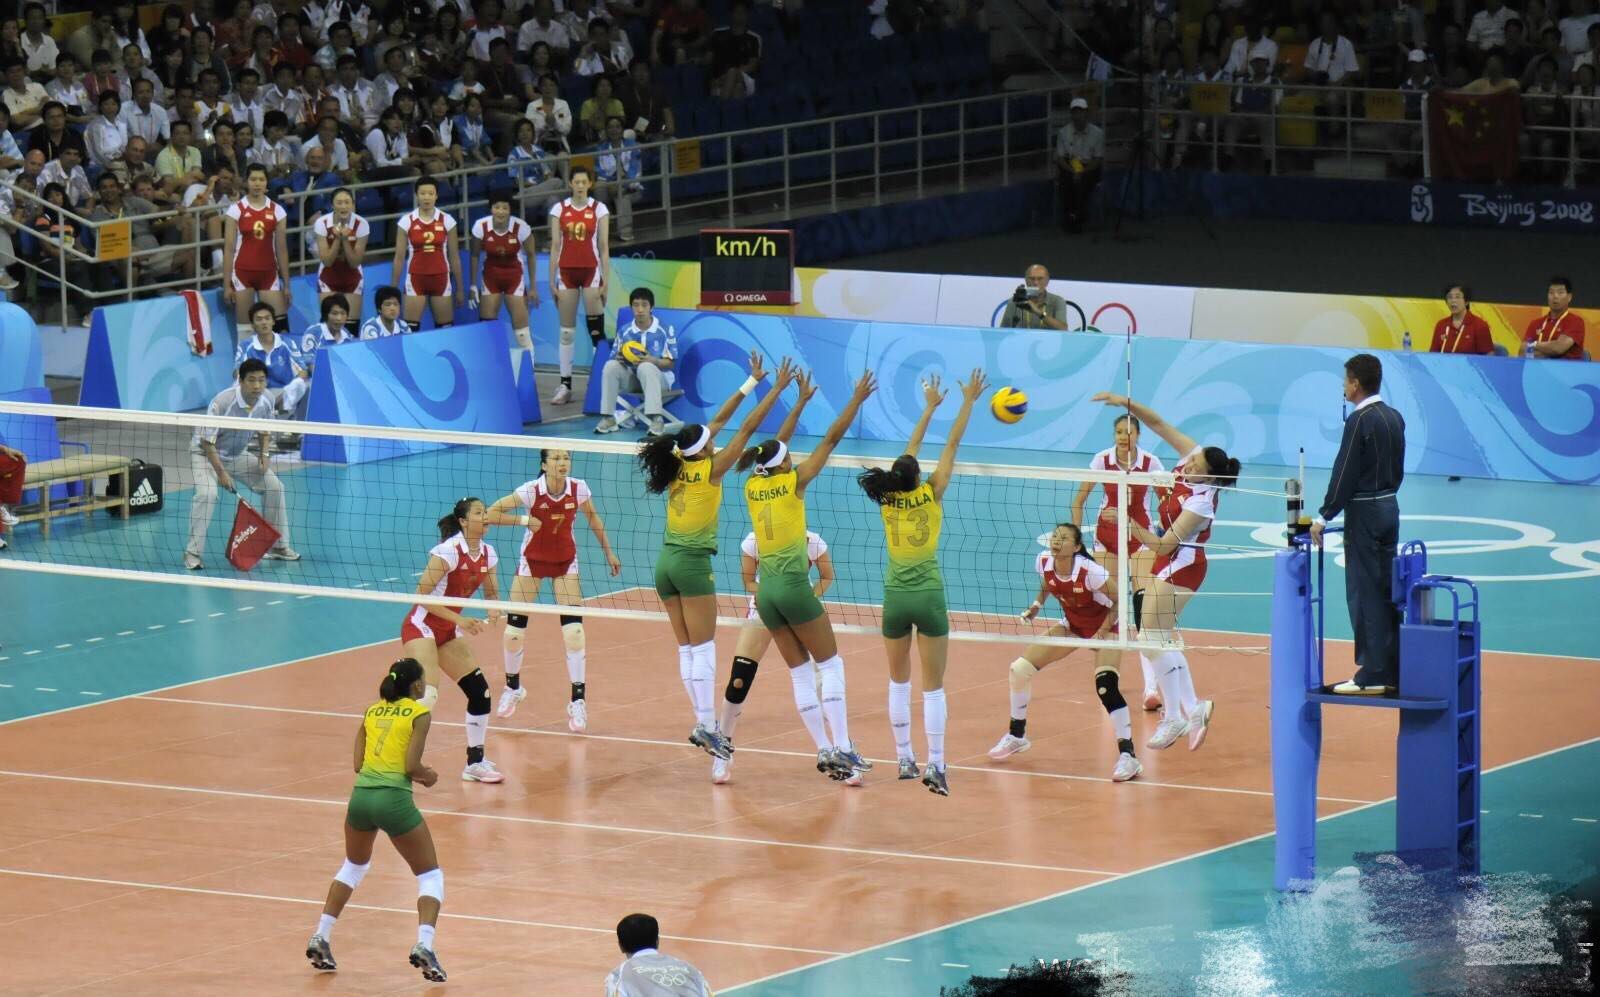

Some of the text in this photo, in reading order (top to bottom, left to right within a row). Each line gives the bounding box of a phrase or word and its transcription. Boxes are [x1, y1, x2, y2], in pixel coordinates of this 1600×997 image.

[1458, 193, 1594, 226] Beijing 2008
[253, 220, 265, 241] 6
[566, 221, 587, 241] 10
[716, 235, 776, 257] km/h
[735, 294, 767, 302] OMEGA
[130, 494, 159, 506] adidas
[551, 514, 565, 535] 7
[757, 503, 774, 540] 1
[886, 508, 930, 548] 13
[374, 718, 394, 757] 7
